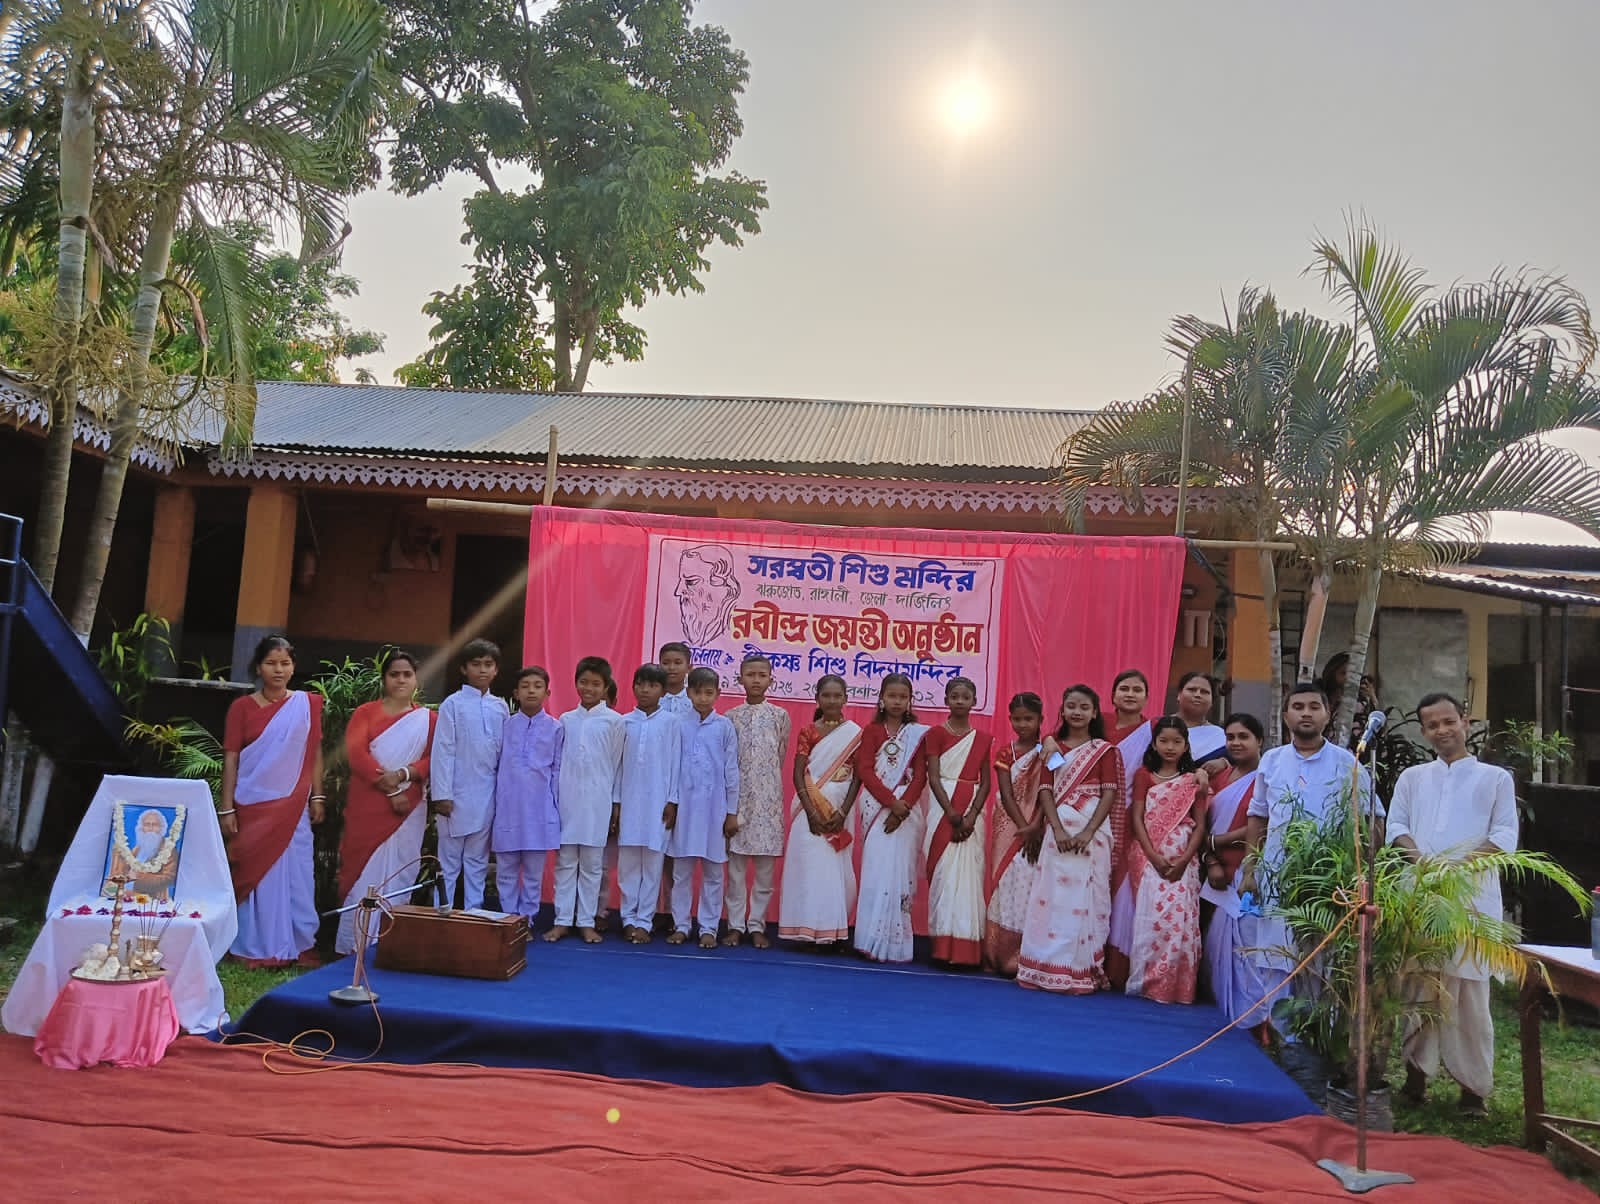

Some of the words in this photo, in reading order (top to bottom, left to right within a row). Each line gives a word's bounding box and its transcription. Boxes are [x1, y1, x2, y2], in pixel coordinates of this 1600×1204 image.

[747, 552, 835, 582] সরস্বতী
[839, 553, 890, 586] শিশু
[894, 560, 977, 592] মন্দির
[732, 601, 809, 643] রবীন্দ্র
[811, 607, 890, 651] জয়ন্তী
[892, 612, 985, 662] অনুষ্ঠান
[808, 647, 847, 677] শিশু
[768, 680, 793, 696] ০২৫
